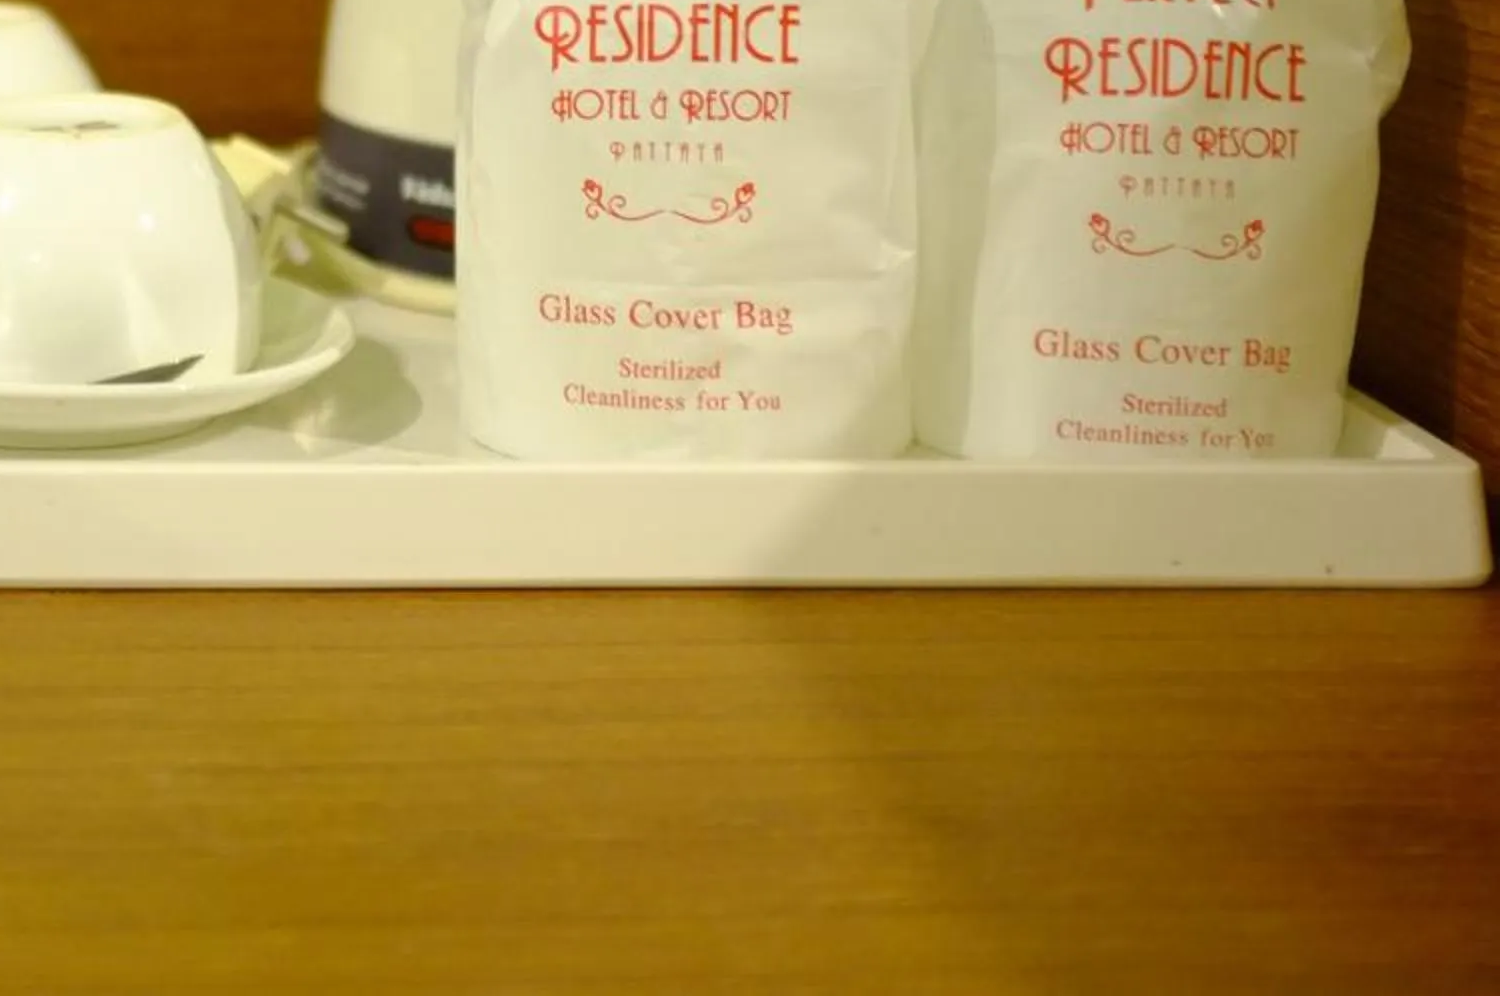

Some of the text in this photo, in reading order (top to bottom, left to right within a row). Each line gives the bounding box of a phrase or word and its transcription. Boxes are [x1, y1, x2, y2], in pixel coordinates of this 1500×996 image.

[533, 1, 801, 72] RESIDENCE
[1043, 35, 1307, 105] RESIDENCE
[550, 88, 792, 123] HOTEL & RESORT
[609, 140, 725, 164] PATTAYA
[1059, 122, 1300, 160] HOTEL & RESORT
[537, 293, 794, 336] Glass Cover Bag
[1032, 327, 1293, 375] Glass Cover Bag
[618, 357, 722, 382] Sterilized
[562, 383, 783, 414] Cleanliness for You
[1120, 392, 1228, 419] Sterilized
[1054, 419, 1190, 447] Cleanliness
[1198, 429, 1234, 449] for
